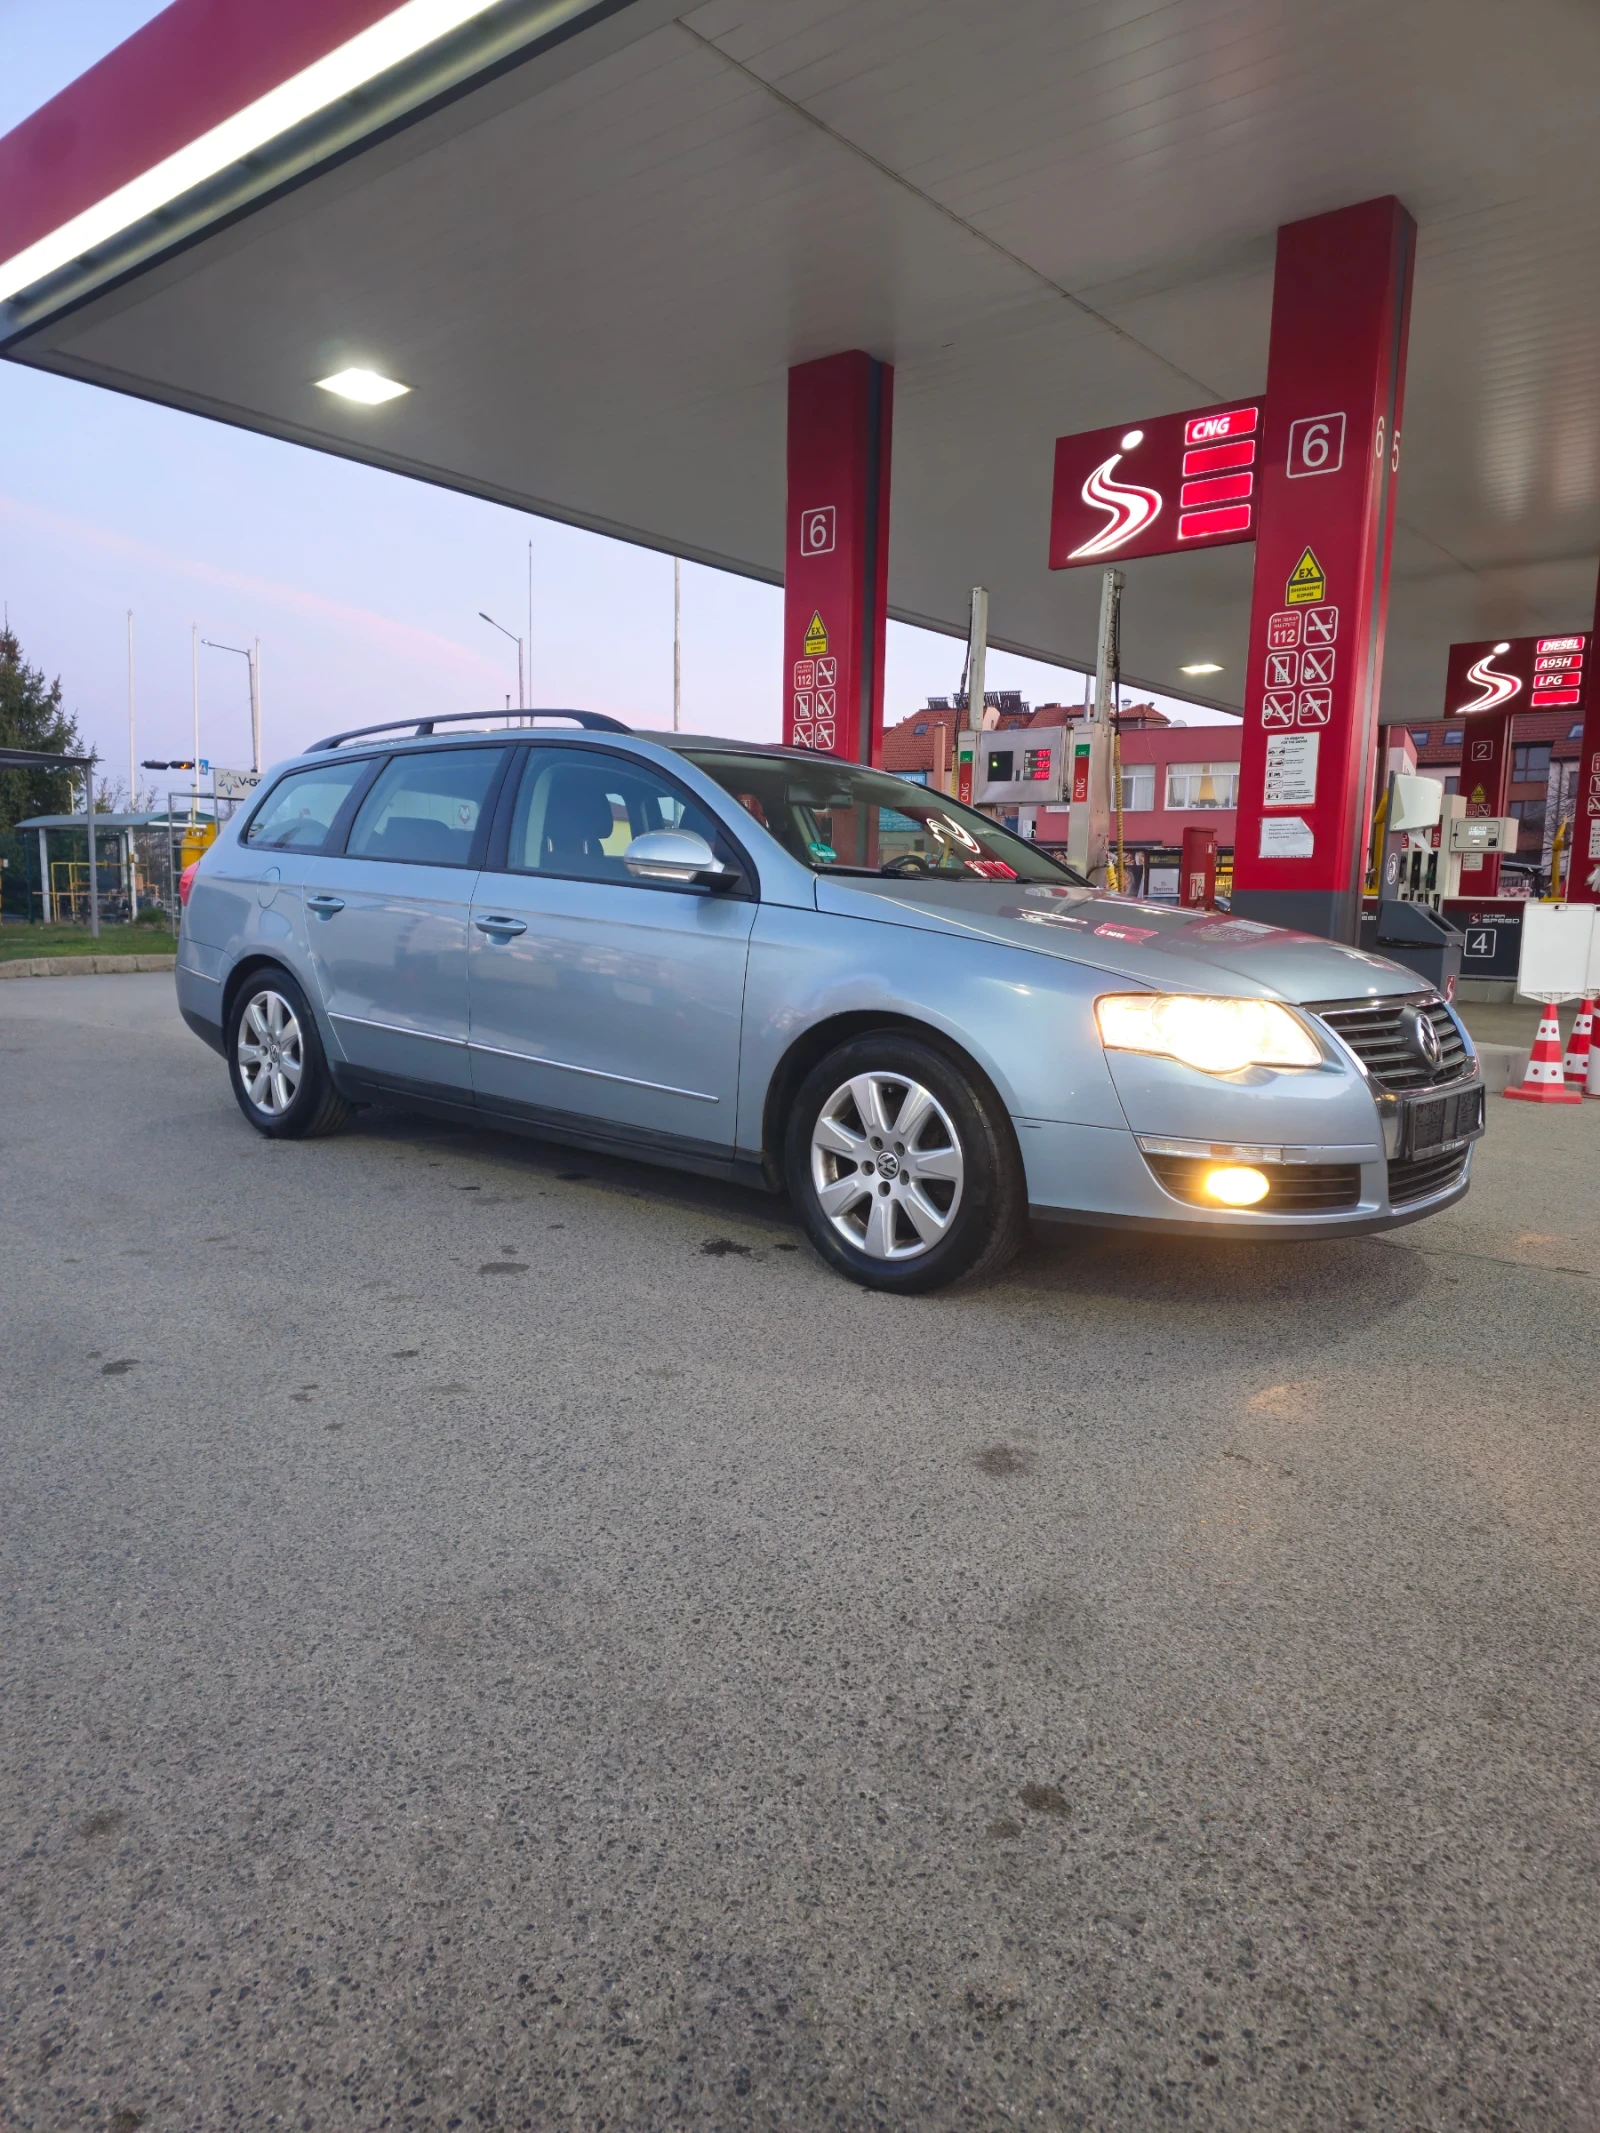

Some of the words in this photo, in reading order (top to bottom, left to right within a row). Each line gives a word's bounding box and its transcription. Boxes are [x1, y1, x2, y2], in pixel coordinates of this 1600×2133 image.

[1192, 417, 1231, 439] CNG
[1302, 424, 1330, 467] 6
[1375, 416, 1385, 458] 6
[1391, 430, 1400, 472] 5
[810, 514, 827, 548] 6
[1299, 567, 1314, 578] EX
[812, 627, 821, 635] EX
[1273, 629, 1296, 644] 112
[1542, 638, 1579, 651] DIESEL
[1539, 657, 1573, 669] A95H
[797, 674, 811, 686] 112
[1538, 675, 1563, 686] LPG
[1476, 743, 1487, 758] 2
[961, 782, 970, 802] CNG
[1076, 777, 1086, 798] CNG
[1472, 932, 1488, 954] 4
